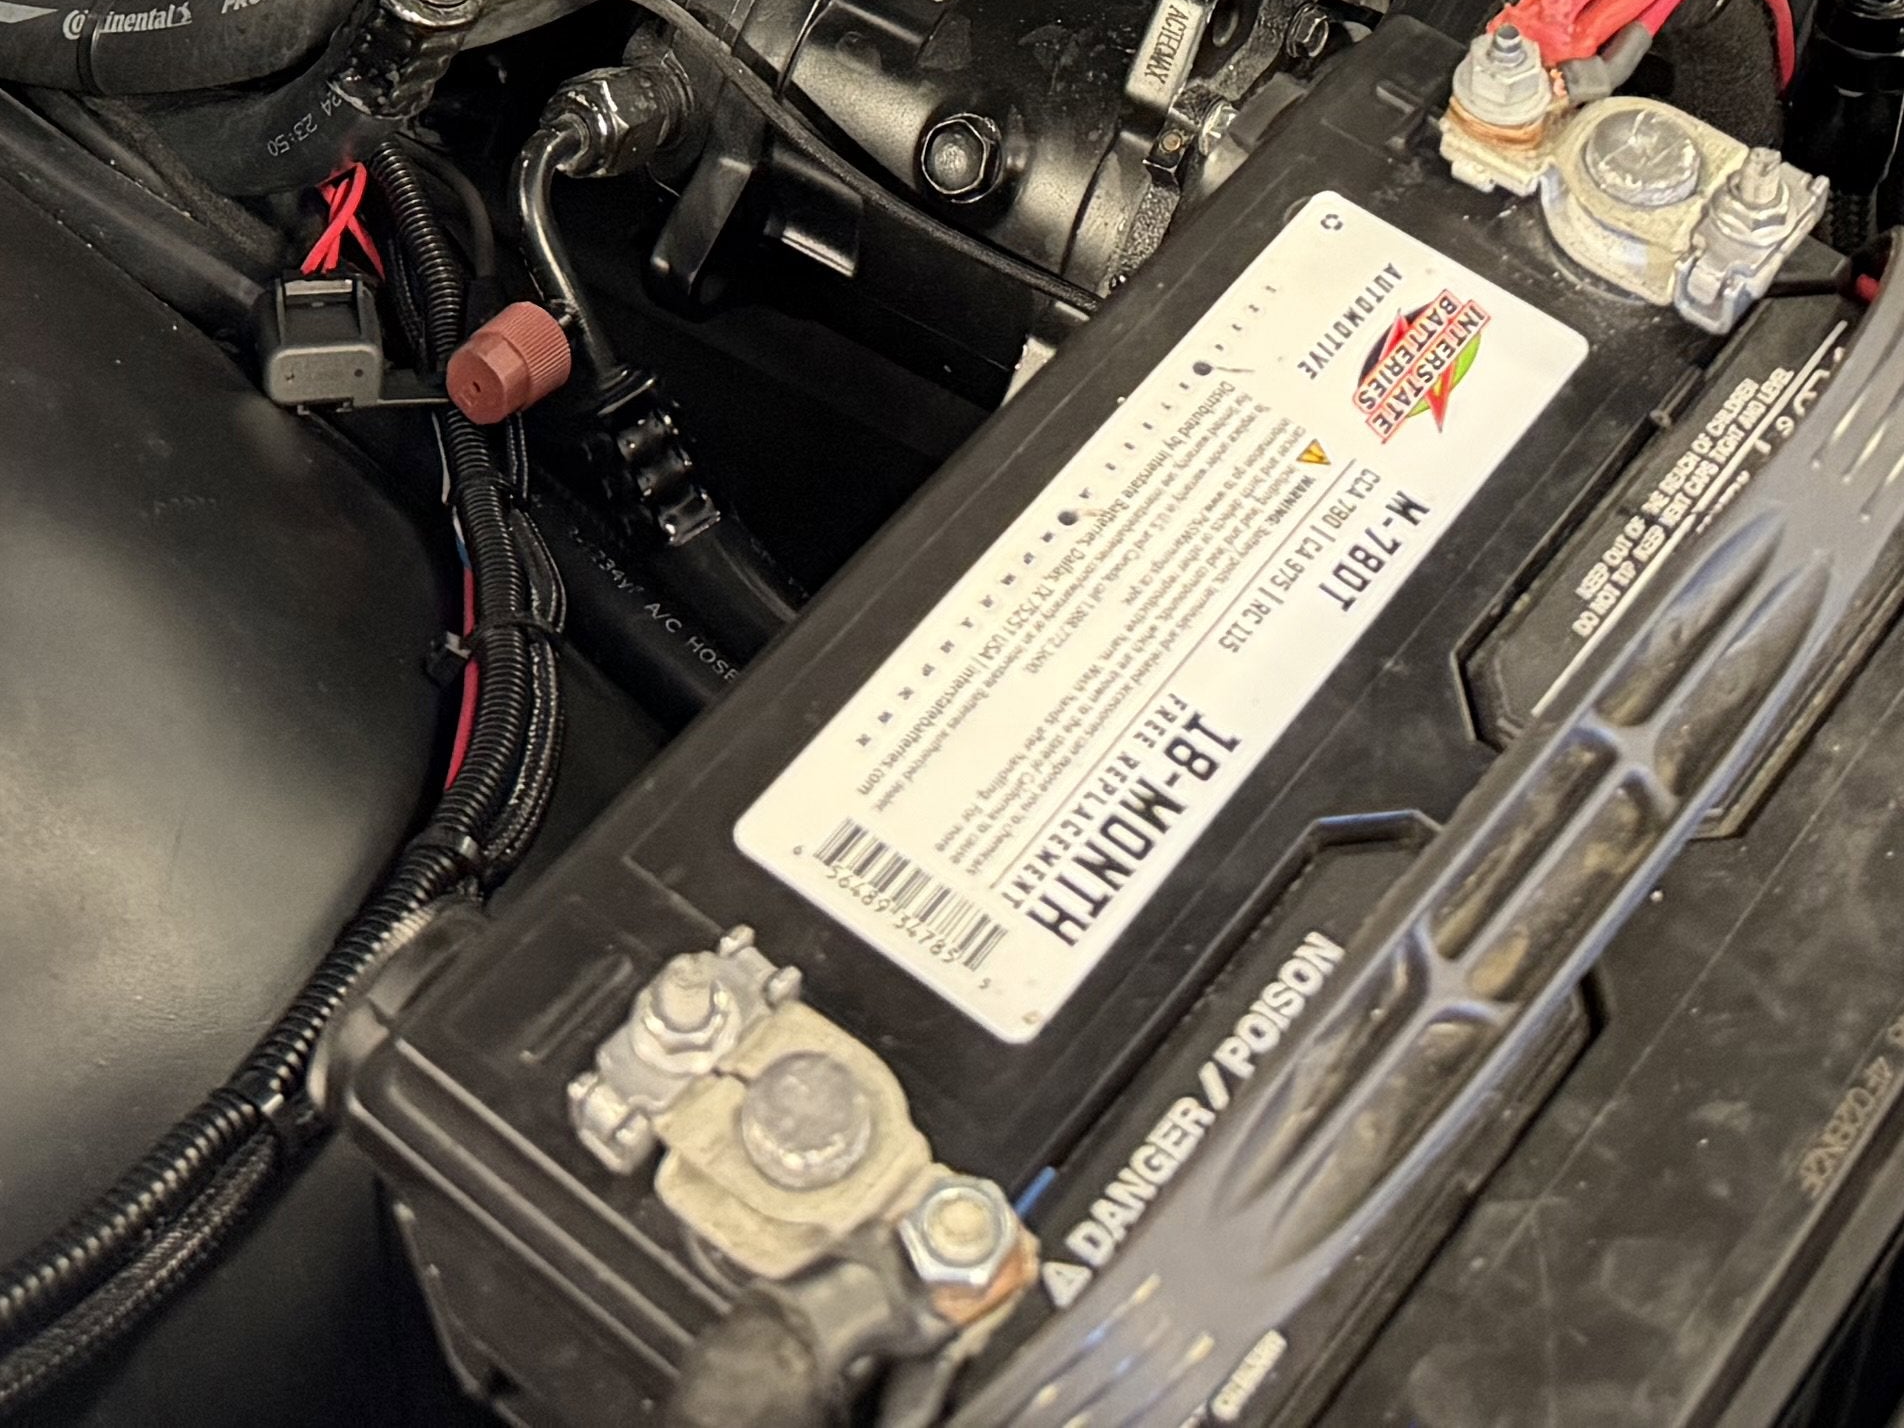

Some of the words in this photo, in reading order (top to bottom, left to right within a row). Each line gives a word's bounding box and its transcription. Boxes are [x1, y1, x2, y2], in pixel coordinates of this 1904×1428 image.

[61, 0, 175, 39] Coinental
[264, 109, 320, 161] 23:50
[1294, 262, 1405, 379] AUTOMOTIVE
[1353, 294, 1459, 410] BATTERIES
[1369, 305, 1487, 435] INTERSTATE
[1175, 378, 1235, 438] Distributed
[1701, 375, 1761, 440] CHILDREN
[1162, 433, 1186, 453] by
[1688, 430, 1715, 458] OF
[1119, 447, 1173, 501] Interstate
[1343, 466, 1381, 501] CCA
[1656, 448, 1702, 497] REACH
[1074, 496, 1130, 551] Batteries,
[1571, 607, 1600, 637] DO
[1587, 580, 1622, 616] NOT
[1629, 521, 1668, 564] KEEP
[1656, 489, 1694, 530] VENT
[1679, 456, 1720, 500] CAPS
[1706, 422, 1747, 466] TIGHT
[1734, 396, 1768, 432] AND
[1638, 487, 1670, 520] THE
[1292, 535, 1324, 562] CA
[1621, 513, 1649, 542] OF
[1043, 545, 1086, 587] Dallas,
[1313, 489, 1429, 612] M-78DT
[1599, 532, 1635, 569] OUT
[1030, 581, 1054, 602] TX
[1268, 556, 1306, 592] 975
[1573, 559, 1613, 601] KEEP
[999, 596, 1041, 636] 75251
[1240, 597, 1272, 625] RC
[976, 631, 1010, 662] USA
[1216, 620, 1253, 655] 115
[854, 661, 982, 799] interstatebatteries.com
[1131, 691, 1188, 750] FREE
[998, 749, 1140, 910] REPLACEMENT
[1024, 709, 1241, 948] 18-MONTH
